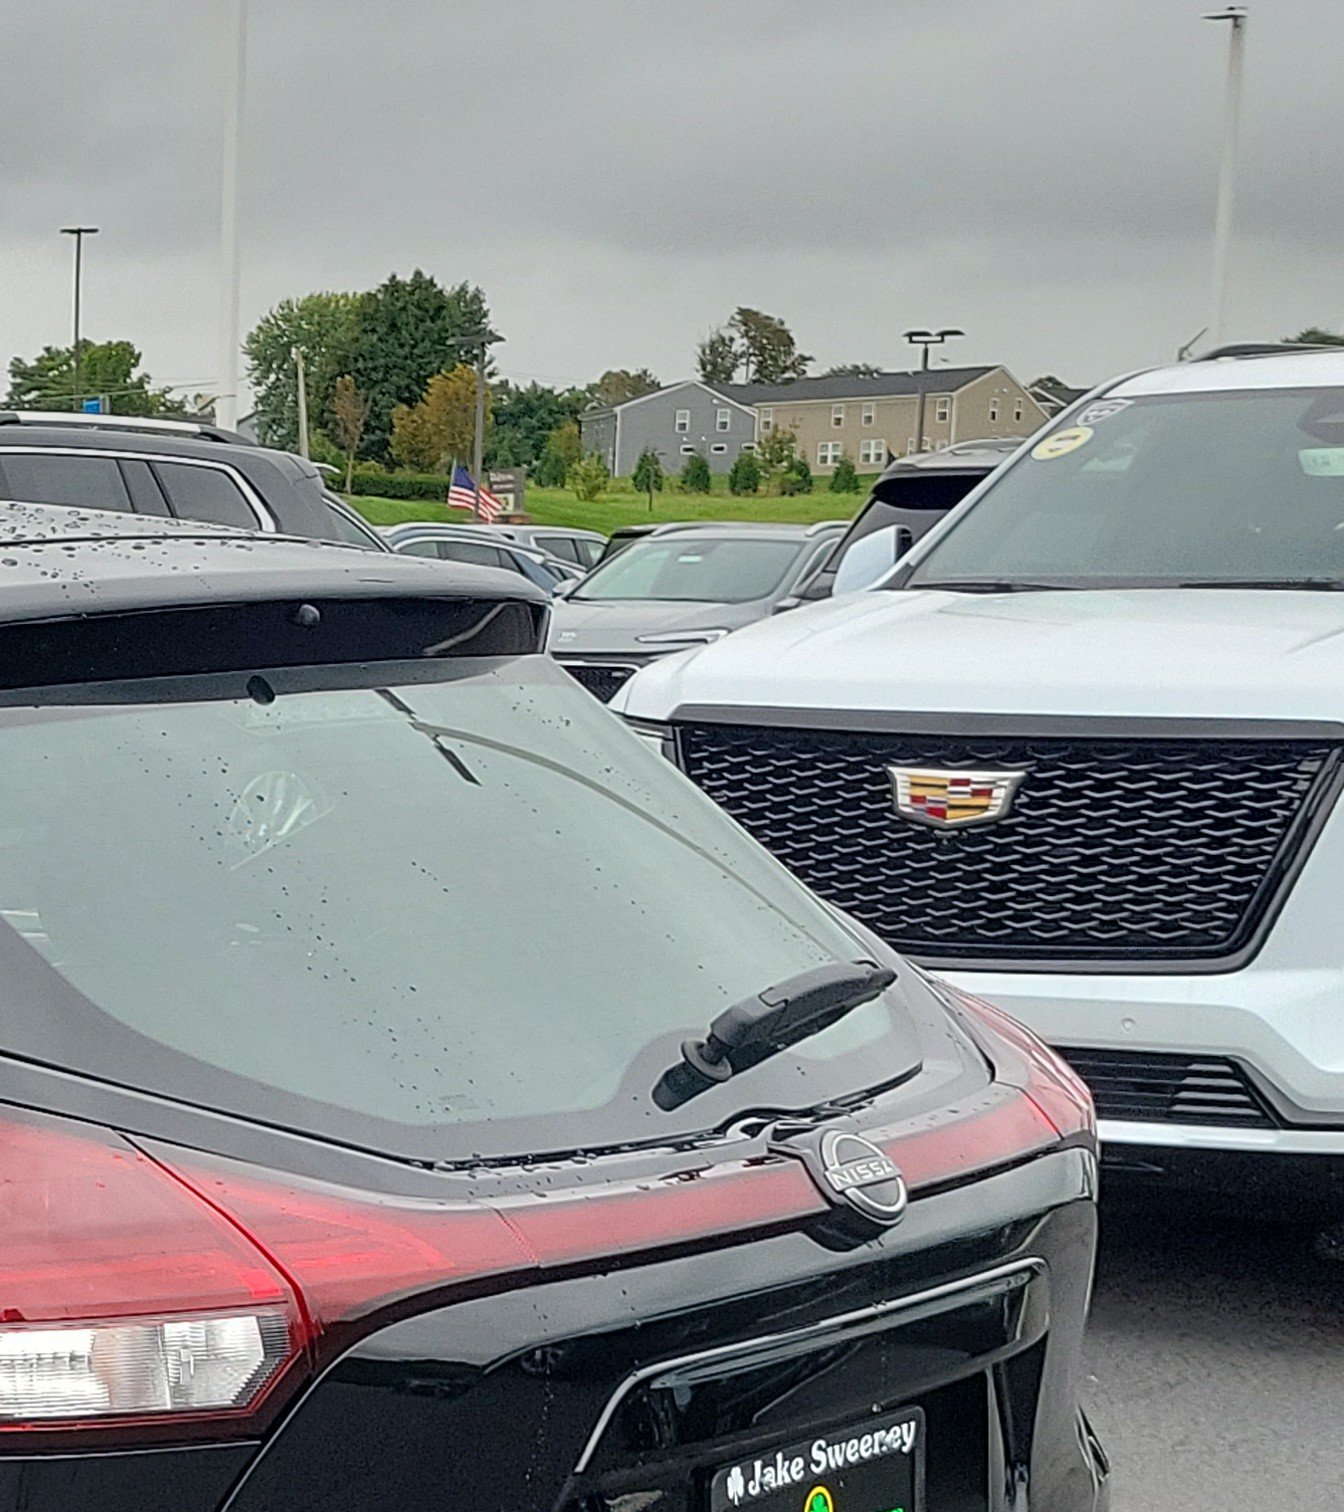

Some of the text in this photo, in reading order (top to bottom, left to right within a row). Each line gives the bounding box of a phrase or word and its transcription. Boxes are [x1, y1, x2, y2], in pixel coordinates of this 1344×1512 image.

[830, 1160, 896, 1187] NISSA
[748, 1420, 916, 1497] Jake Sweeney
